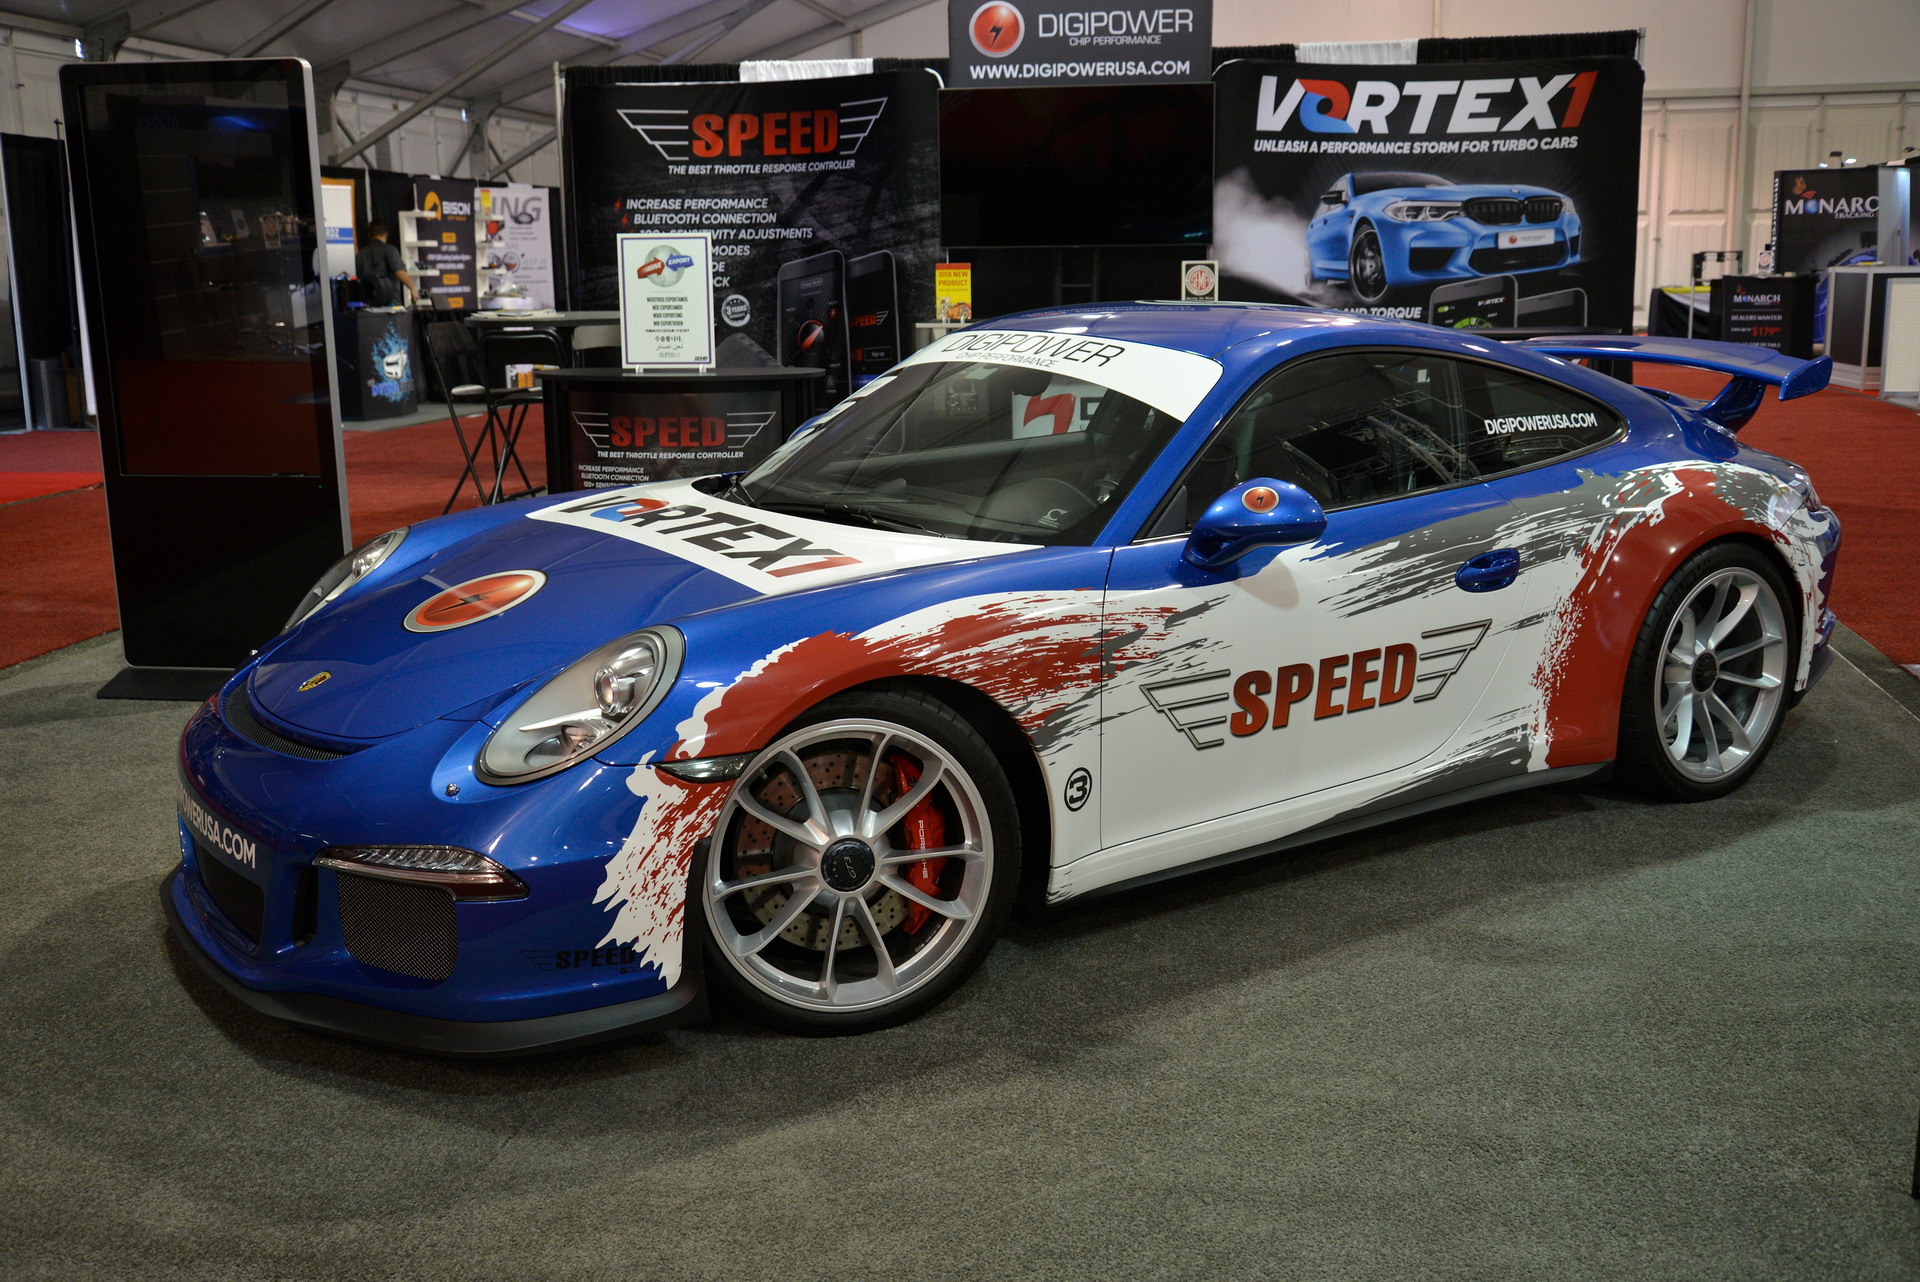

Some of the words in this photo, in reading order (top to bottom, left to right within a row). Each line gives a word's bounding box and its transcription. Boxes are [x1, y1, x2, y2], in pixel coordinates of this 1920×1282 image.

[1038, 9, 1193, 38] DIGIPOWER
[1069, 37, 1091, 47] CHIP
[1093, 35, 1162, 46] PERFORMANCE
[970, 61, 1190, 79] WWW.DIGIPOWERUSA.COM
[1256, 70, 1599, 134] VORTEX1
[692, 109, 838, 158] SPEED
[1253, 139, 1308, 153] UNLEASH
[1308, 141, 1319, 153] A
[1320, 140, 1411, 154] PERFORMANCE
[1412, 140, 1460, 154] STORM
[1461, 139, 1490, 153] FOR
[1492, 138, 1538, 152] TURBO
[1540, 136, 1578, 150] CARS
[668, 165, 686, 175] THE
[688, 165, 712, 175] BEST
[714, 164, 761, 174] THROTTLE
[762, 163, 807, 173] RESPONSE
[808, 159, 855, 172] CONTROLLER
[442, 201, 471, 216] BISON
[626, 198, 682, 210] INCREASE
[684, 198, 768, 210] PERFORMANCE
[1784, 195, 1880, 216] MONARC
[634, 213, 700, 225] BLUETOOTH
[702, 213, 777, 225] CONNECTION
[1835, 211, 1874, 219] TRACKING
[738, 227, 813, 240] ADJUSTMENTS
[711, 245, 750, 256] MODES
[1733, 294, 1781, 303] MONARCH
[1369, 306, 1423, 319] TORQUE
[941, 333, 1126, 367] DIGIPOWER
[956, 351, 982, 360] CHIP
[981, 352, 1059, 368] PERFORMANCE
[610, 416, 725, 448] SPEED
[1484, 412, 1598, 435] DIGIPOWERUSA.COM
[597, 450, 609, 458] THE
[610, 451, 624, 459] BEST
[626, 451, 657, 459] THROTTLE
[697, 451, 744, 459] CONTROLLER
[578, 464, 601, 472] INCREASE
[602, 465, 645, 474] PERFORMANCE
[581, 473, 610, 481] BLUETOOTH
[610, 474, 650, 482] CONNECTION
[557, 495, 864, 578] VORTEX1
[1230, 642, 1418, 738] SPEED
[1069, 775, 1088, 804] 3
[180, 787, 256, 869] OWERUSA.COM
[917, 820, 929, 879] PORSHE
[556, 947, 636, 969] SPEED
